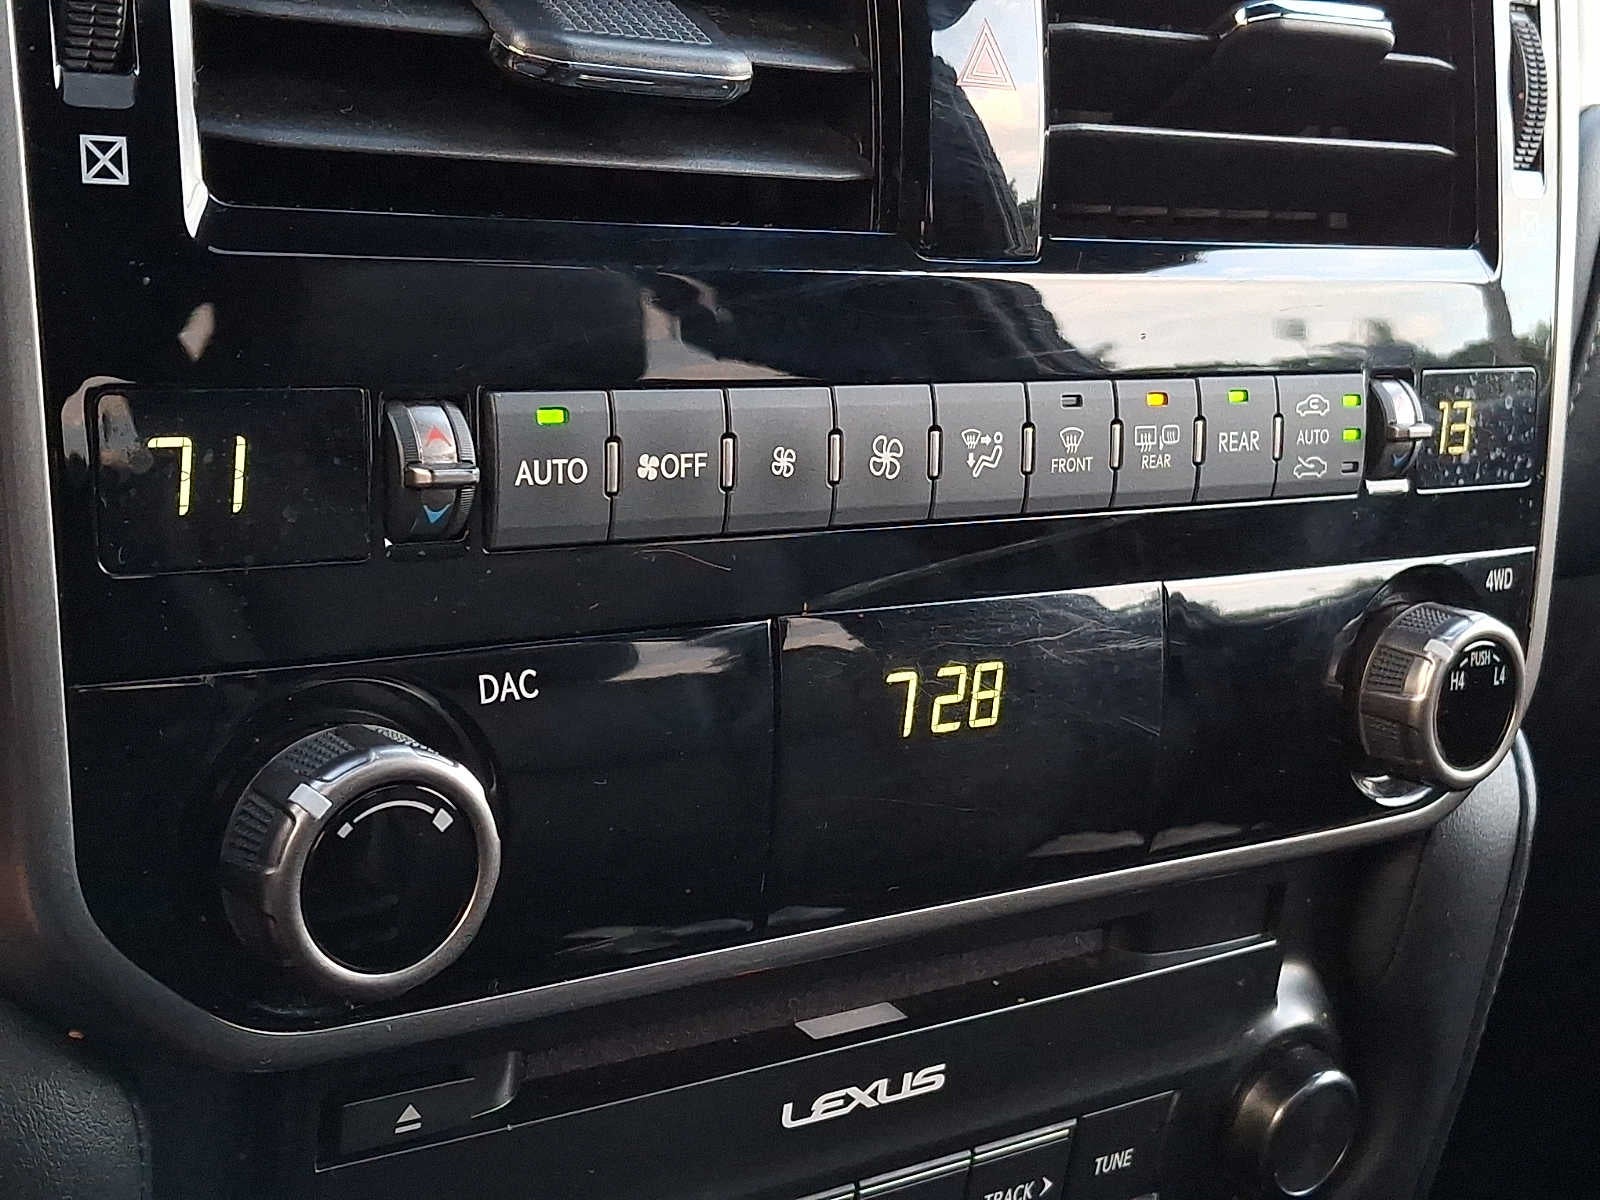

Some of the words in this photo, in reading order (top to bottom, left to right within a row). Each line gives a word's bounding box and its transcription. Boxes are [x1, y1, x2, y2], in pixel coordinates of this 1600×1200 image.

[1218, 430, 1260, 455] REAR
[1296, 428, 1330, 446] AUTO
[514, 457, 588, 486] AUTO
[660, 452, 708, 480] OFF
[1050, 456, 1094, 474] FRONT
[1141, 453, 1172, 470] REAR
[147, 435, 246, 516] 71
[1485, 567, 1514, 592] 4WD
[1470, 650, 1491, 668] PUSH
[478, 668, 539, 705] DAC
[1450, 670, 1465, 692] H4
[1493, 665, 1506, 686] L4
[886, 661, 1004, 738] 728
[781, 1063, 947, 1129] LEXUS
[1094, 1147, 1135, 1176] TUNE
